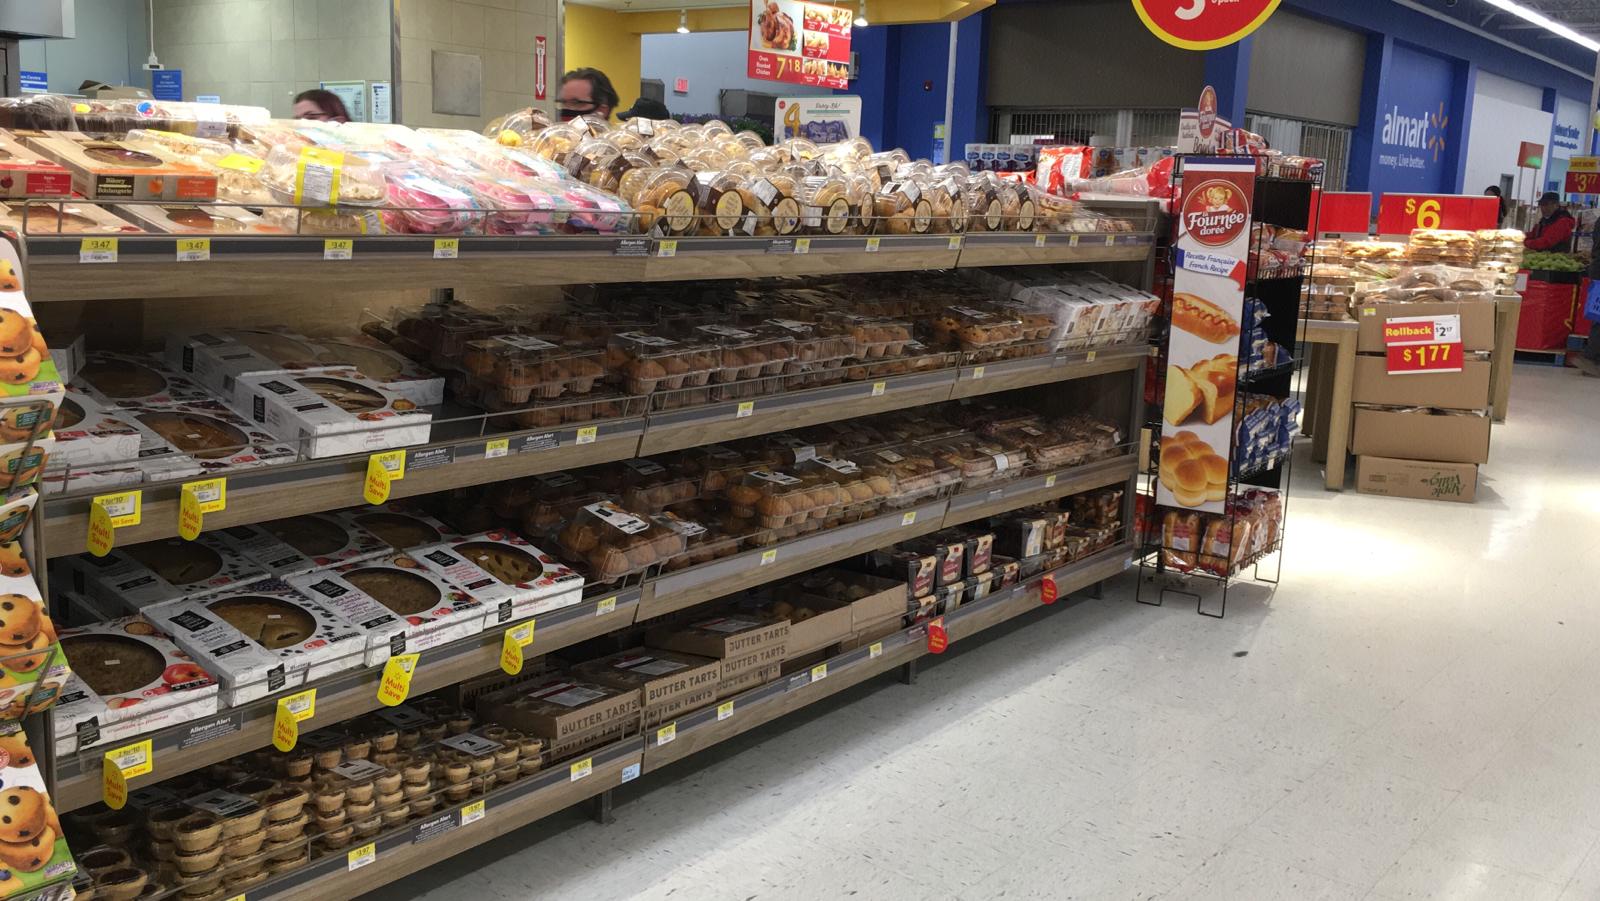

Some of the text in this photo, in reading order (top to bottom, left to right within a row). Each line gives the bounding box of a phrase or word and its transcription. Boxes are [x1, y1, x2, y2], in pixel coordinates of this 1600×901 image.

[1382, 105, 1429, 150] almart
[1187, 211, 1245, 230] Fournée
[1199, 226, 1226, 236] dorée
[1185, 252, 1206, 262] Recette
[1385, 326, 1432, 337] Rollback
[414, 451, 435, 460] Allergen
[368, 475, 387, 490] Multi
[368, 485, 384, 499] Save
[183, 508, 199, 524] Multi
[91, 522, 110, 539] Multi
[183, 518, 197, 533] Save
[91, 533, 108, 549] Save
[729, 626, 789, 652] BUTTER TARTS
[504, 648, 520, 663] Multi
[725, 645, 785, 673] BUTTER TARTS
[385, 678, 405, 693] Multi
[649, 669, 718, 701] BUTTER TARTS
[383, 687, 401, 701] Save
[562, 699, 638, 735] BUTTER TARTS
[190, 717, 232, 735] Allergen Alert
[277, 721, 294, 738] Multi
[277, 732, 292, 746] Save
[105, 778, 123, 793] Multi
[106, 787, 123, 802] Save
[420, 814, 451, 832] Allergen Alert
